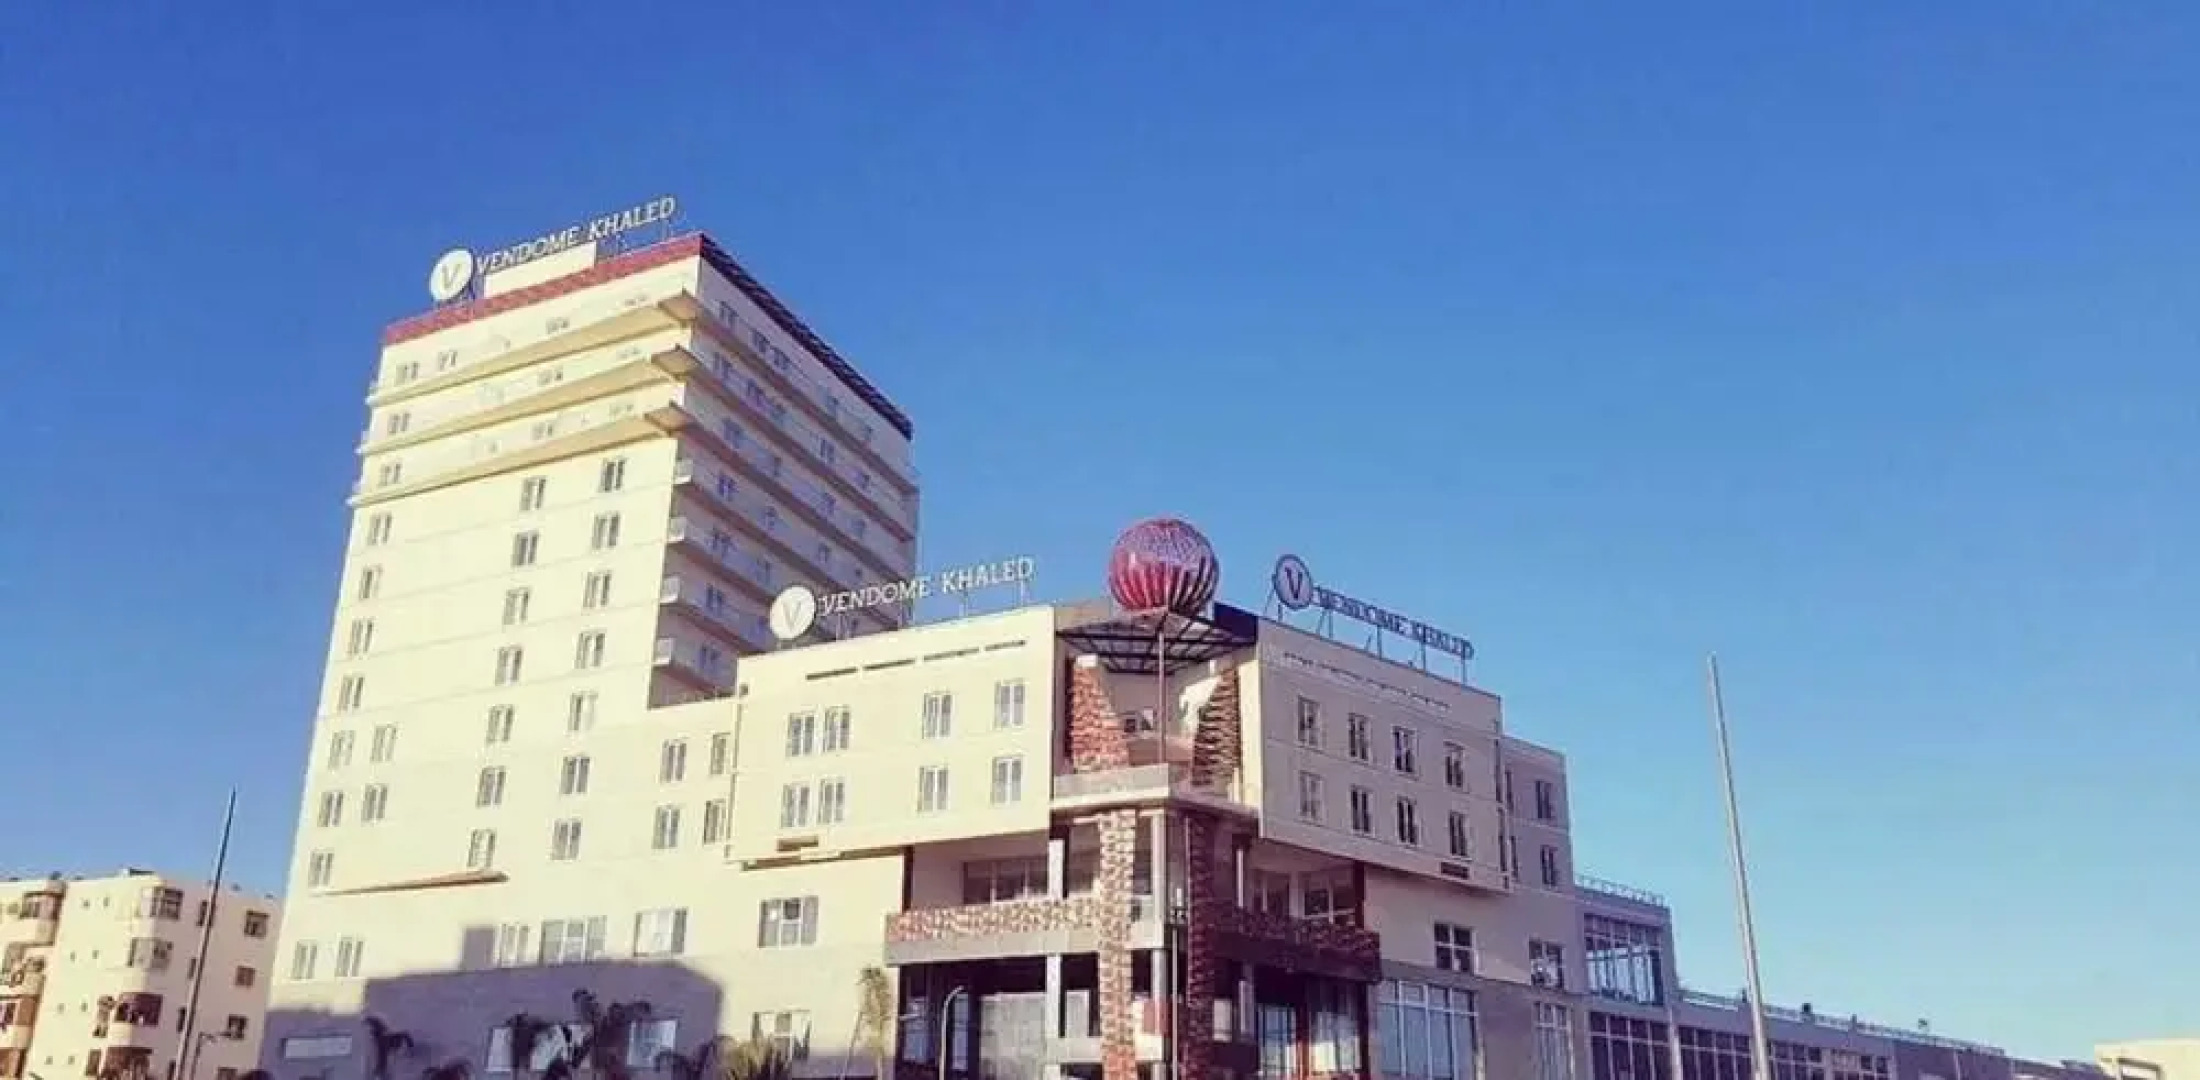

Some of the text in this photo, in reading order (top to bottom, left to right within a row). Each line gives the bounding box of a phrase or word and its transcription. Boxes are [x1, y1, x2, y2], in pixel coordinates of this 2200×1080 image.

[441, 196, 677, 290] V VENDOME KHALED
[782, 555, 1035, 633] V VENDOME KHALED
[1284, 566, 1304, 600] V
